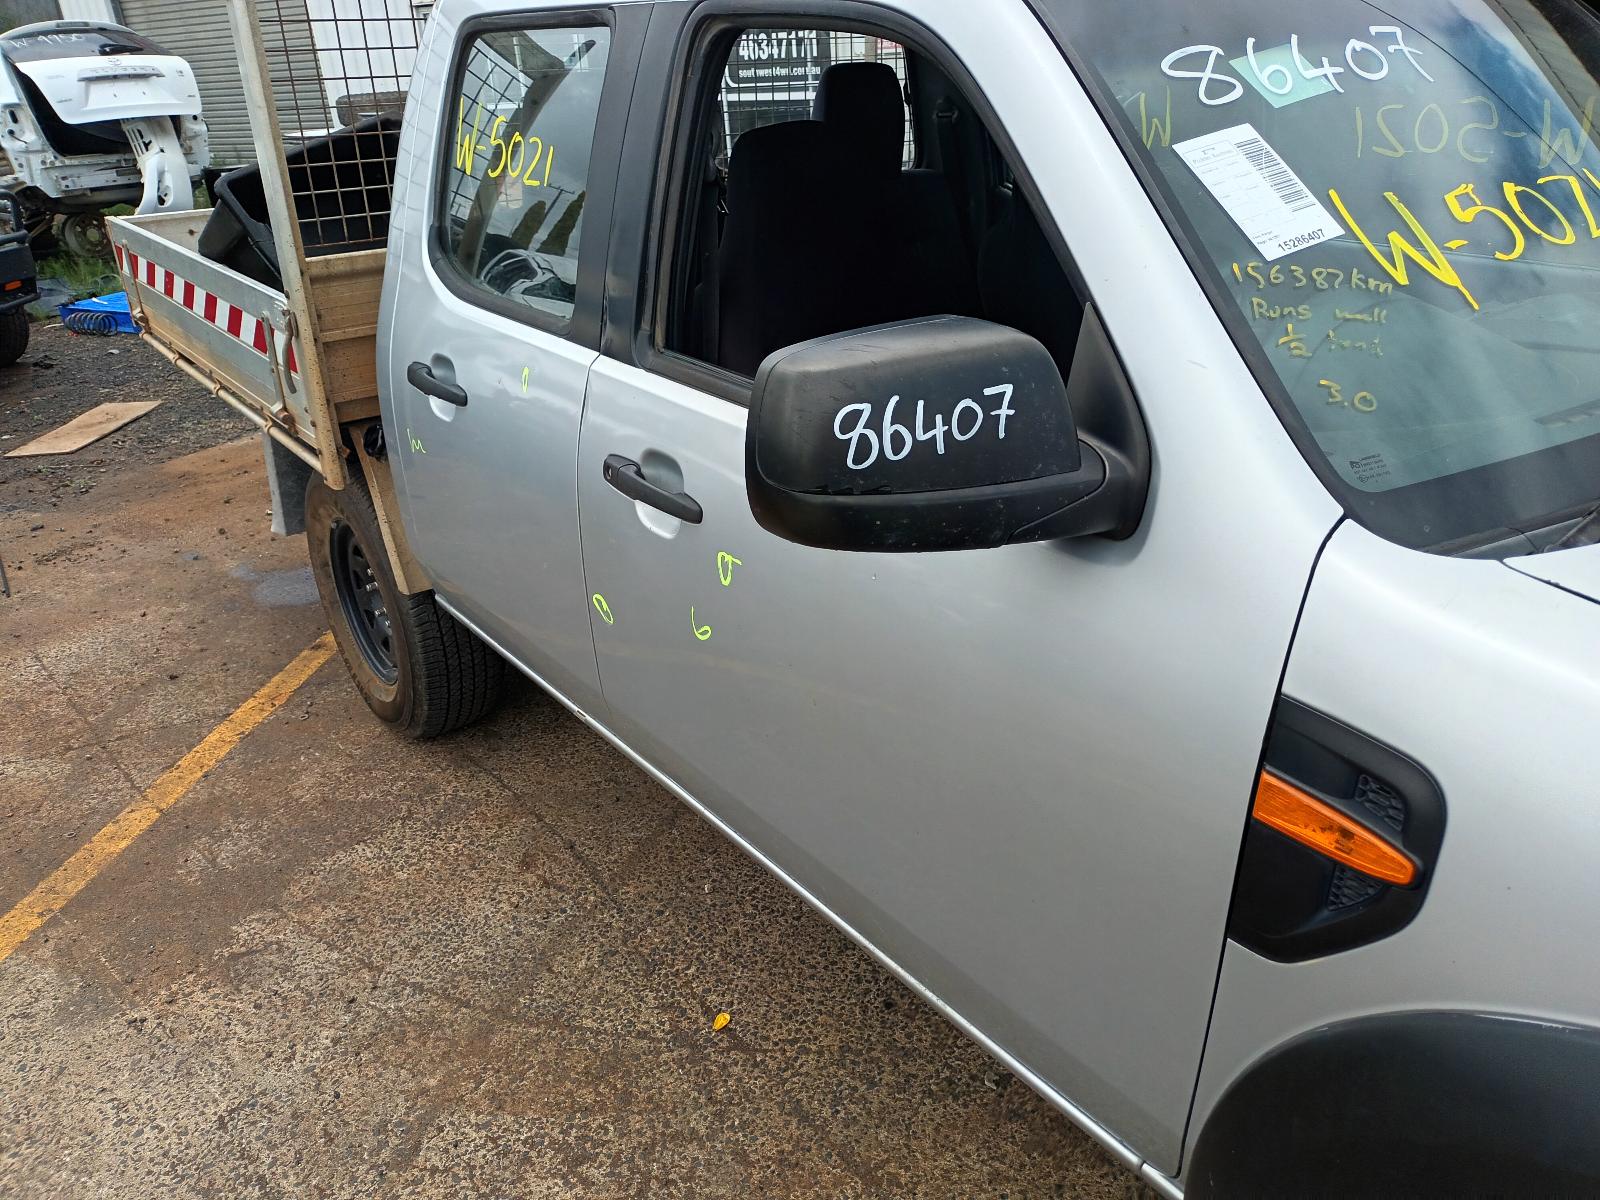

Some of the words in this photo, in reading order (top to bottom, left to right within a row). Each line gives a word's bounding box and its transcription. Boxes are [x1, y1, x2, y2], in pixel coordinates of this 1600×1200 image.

[1160, 25, 1436, 106] 86407
[456, 96, 554, 187] W-5021
[1278, 228, 1326, 252] 15286407
[1328, 168, 1600, 312] W-502
[833, 383, 1015, 470] 86407
